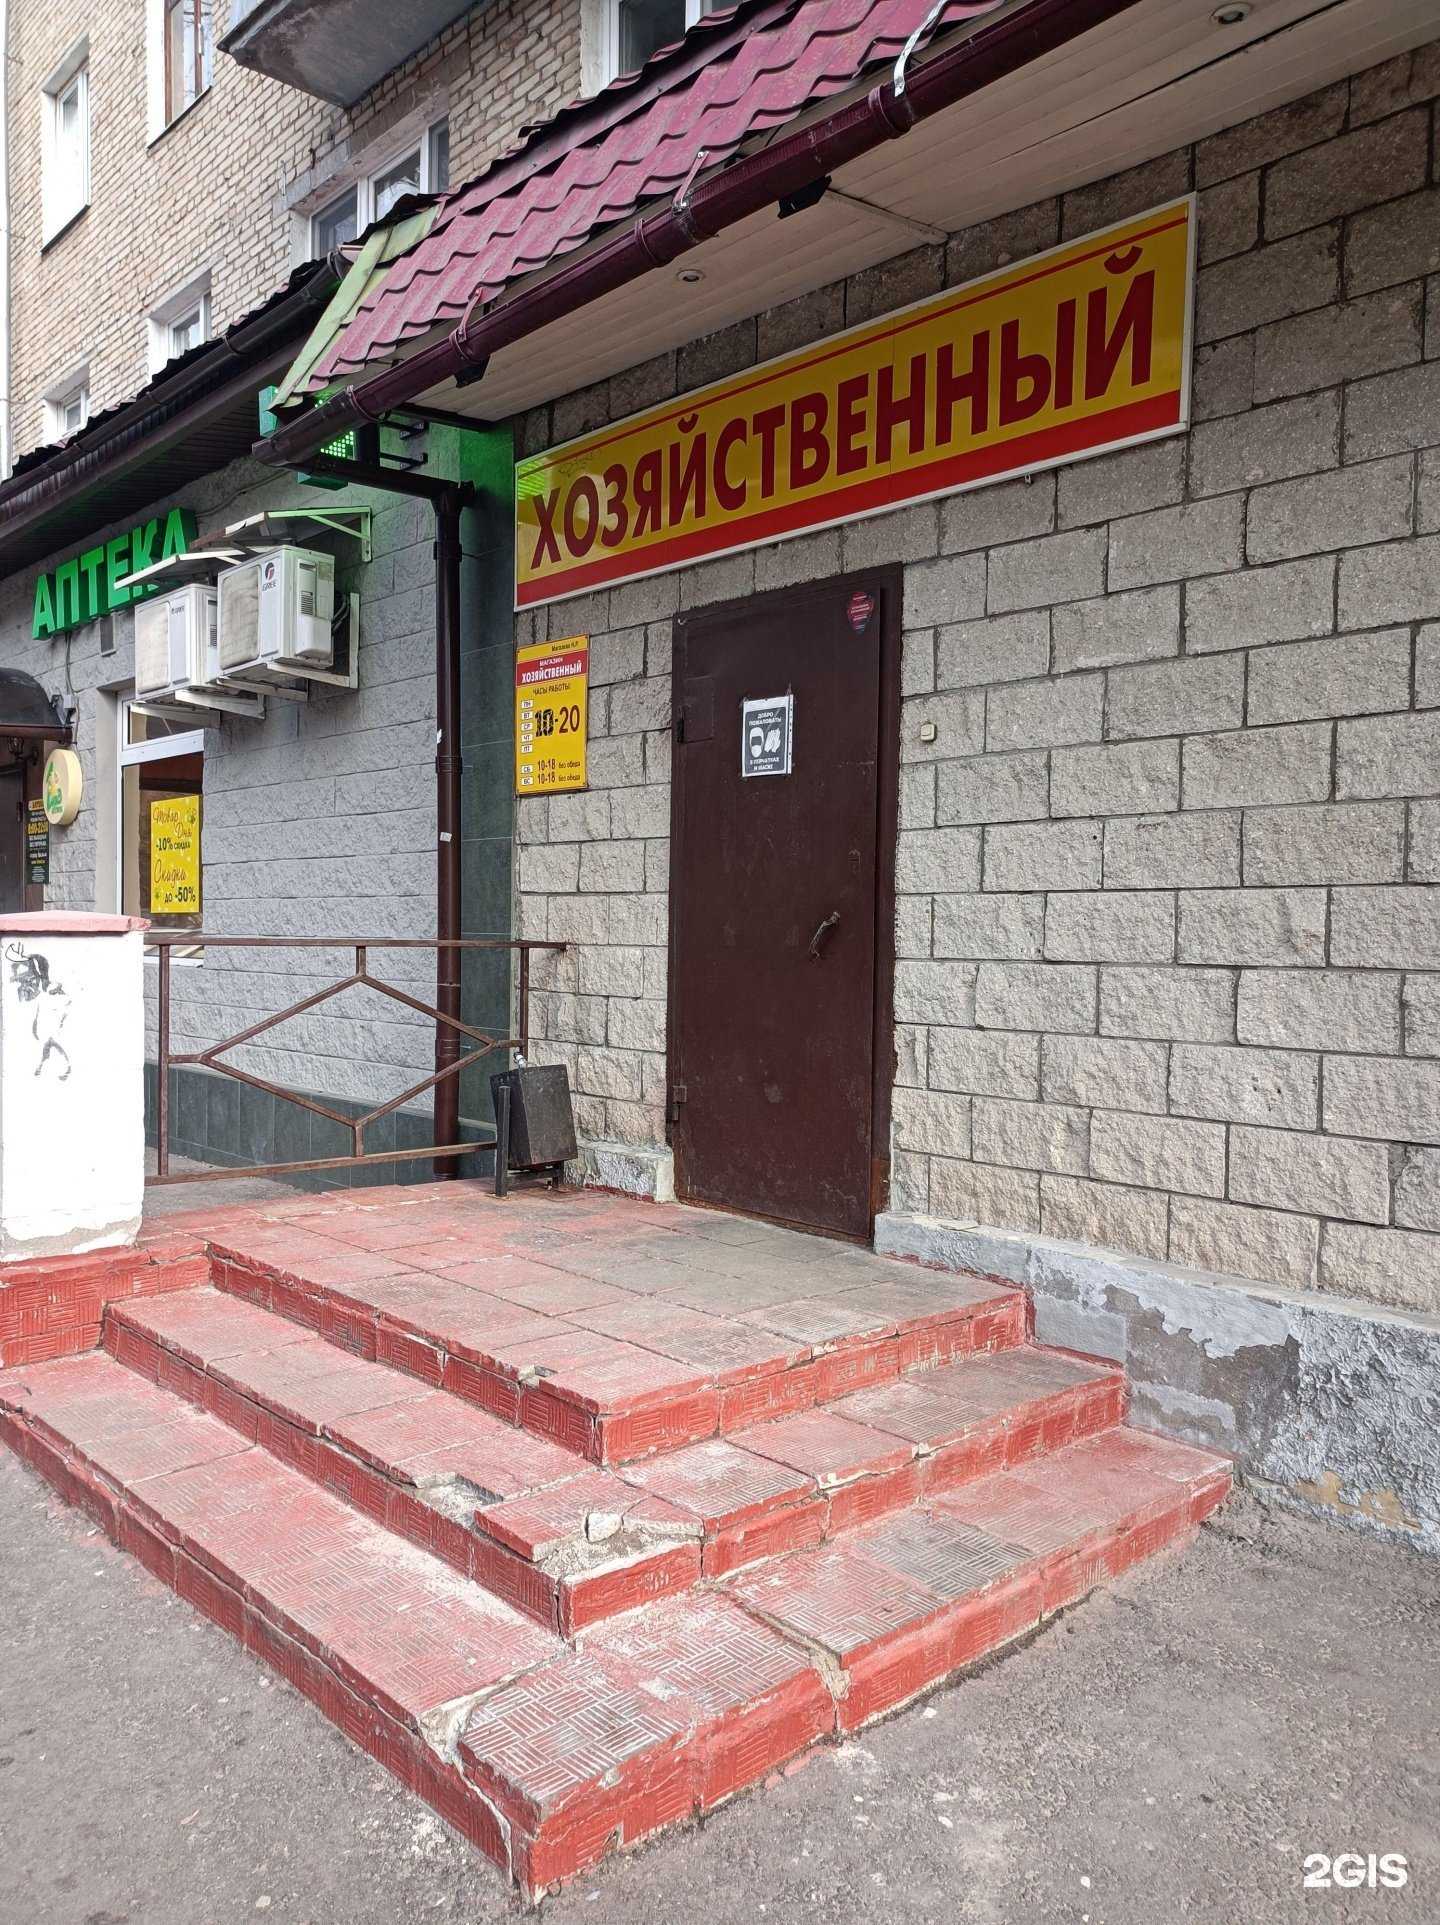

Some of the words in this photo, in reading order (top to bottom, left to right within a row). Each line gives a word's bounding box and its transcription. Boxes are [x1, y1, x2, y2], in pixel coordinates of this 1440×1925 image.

[531, 246, 1156, 569] ХОЗЯЙСТВЕННЫЙ
[32, 507, 190, 640] АПТЕКА
[539, 657, 564, 667] МАГАЗИН
[521, 660, 582, 684] ХОЗЯЙСТВЕННЫЙ
[537, 758, 556, 771] 10-18
[537, 772, 556, 785] 10-18
[156, 837, 173, 852] -10%
[175, 886, 196, 902] -50%
